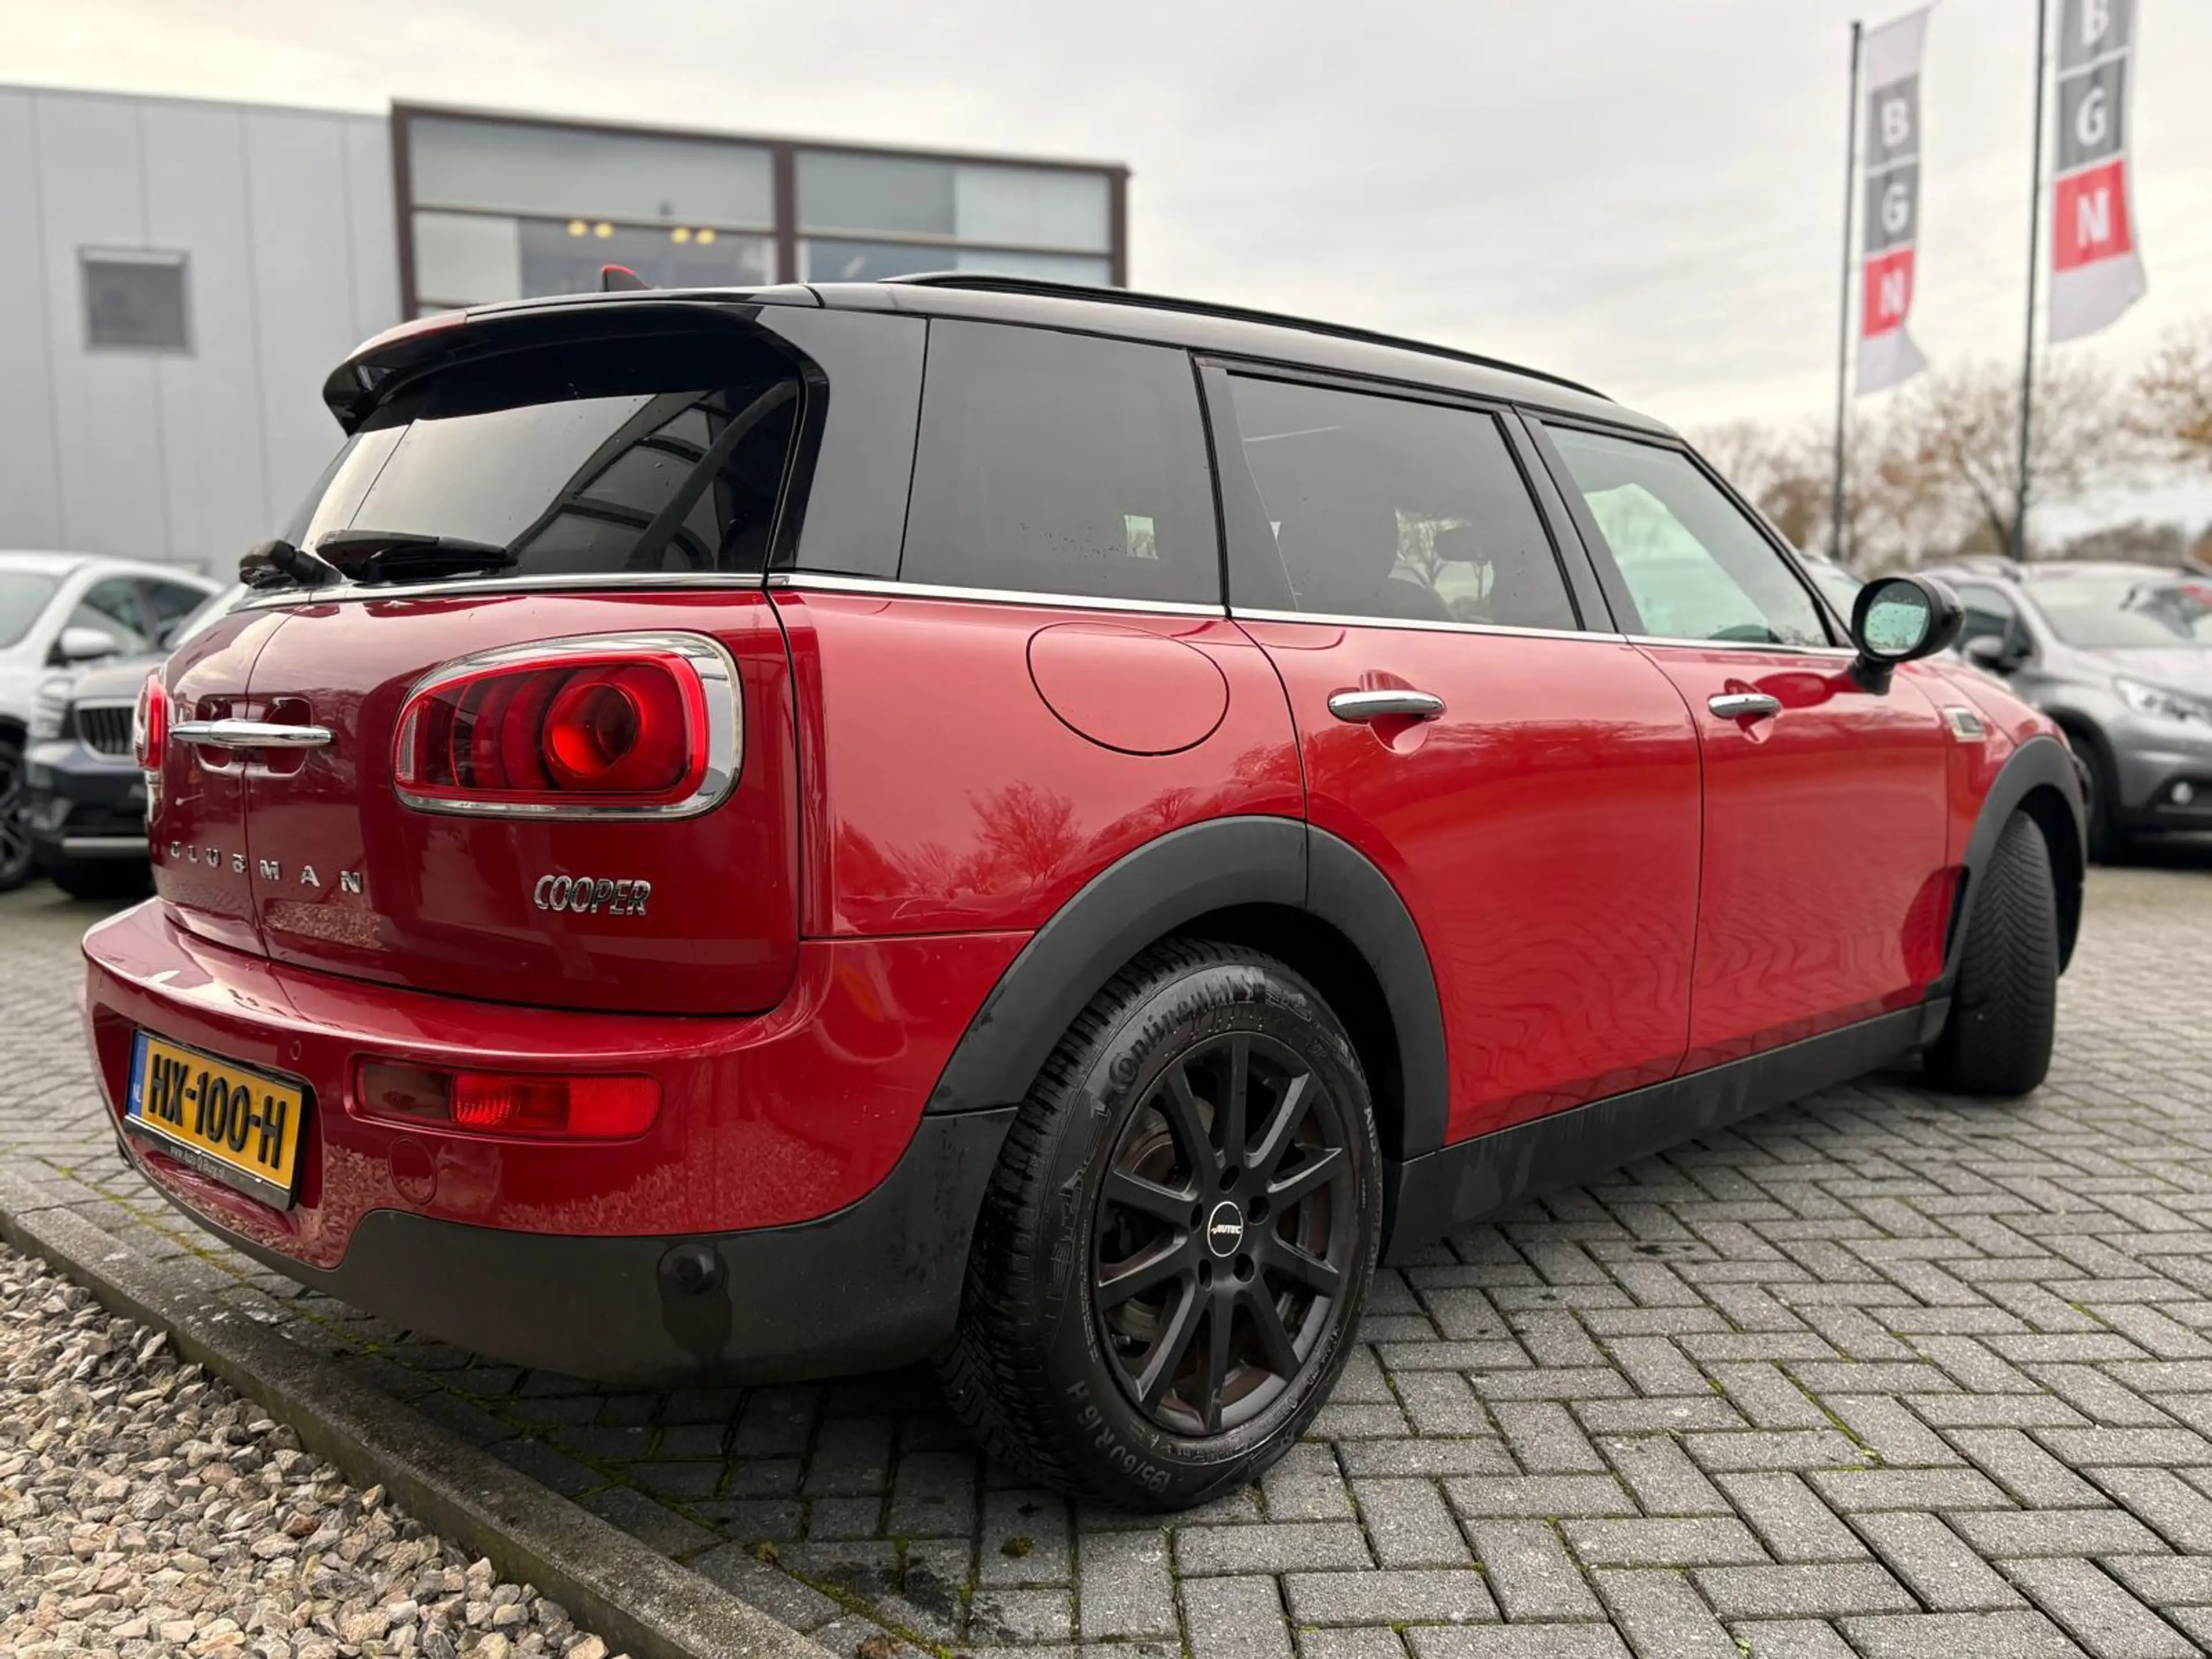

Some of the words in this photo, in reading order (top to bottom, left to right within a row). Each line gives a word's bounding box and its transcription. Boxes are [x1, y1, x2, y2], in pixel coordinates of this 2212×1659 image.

[171, 840, 362, 893] CLUBMAN
[533, 874, 652, 916] COOPER
[148, 1054, 286, 1170] HX-100-H
[1065, 1378, 1090, 1398] H
